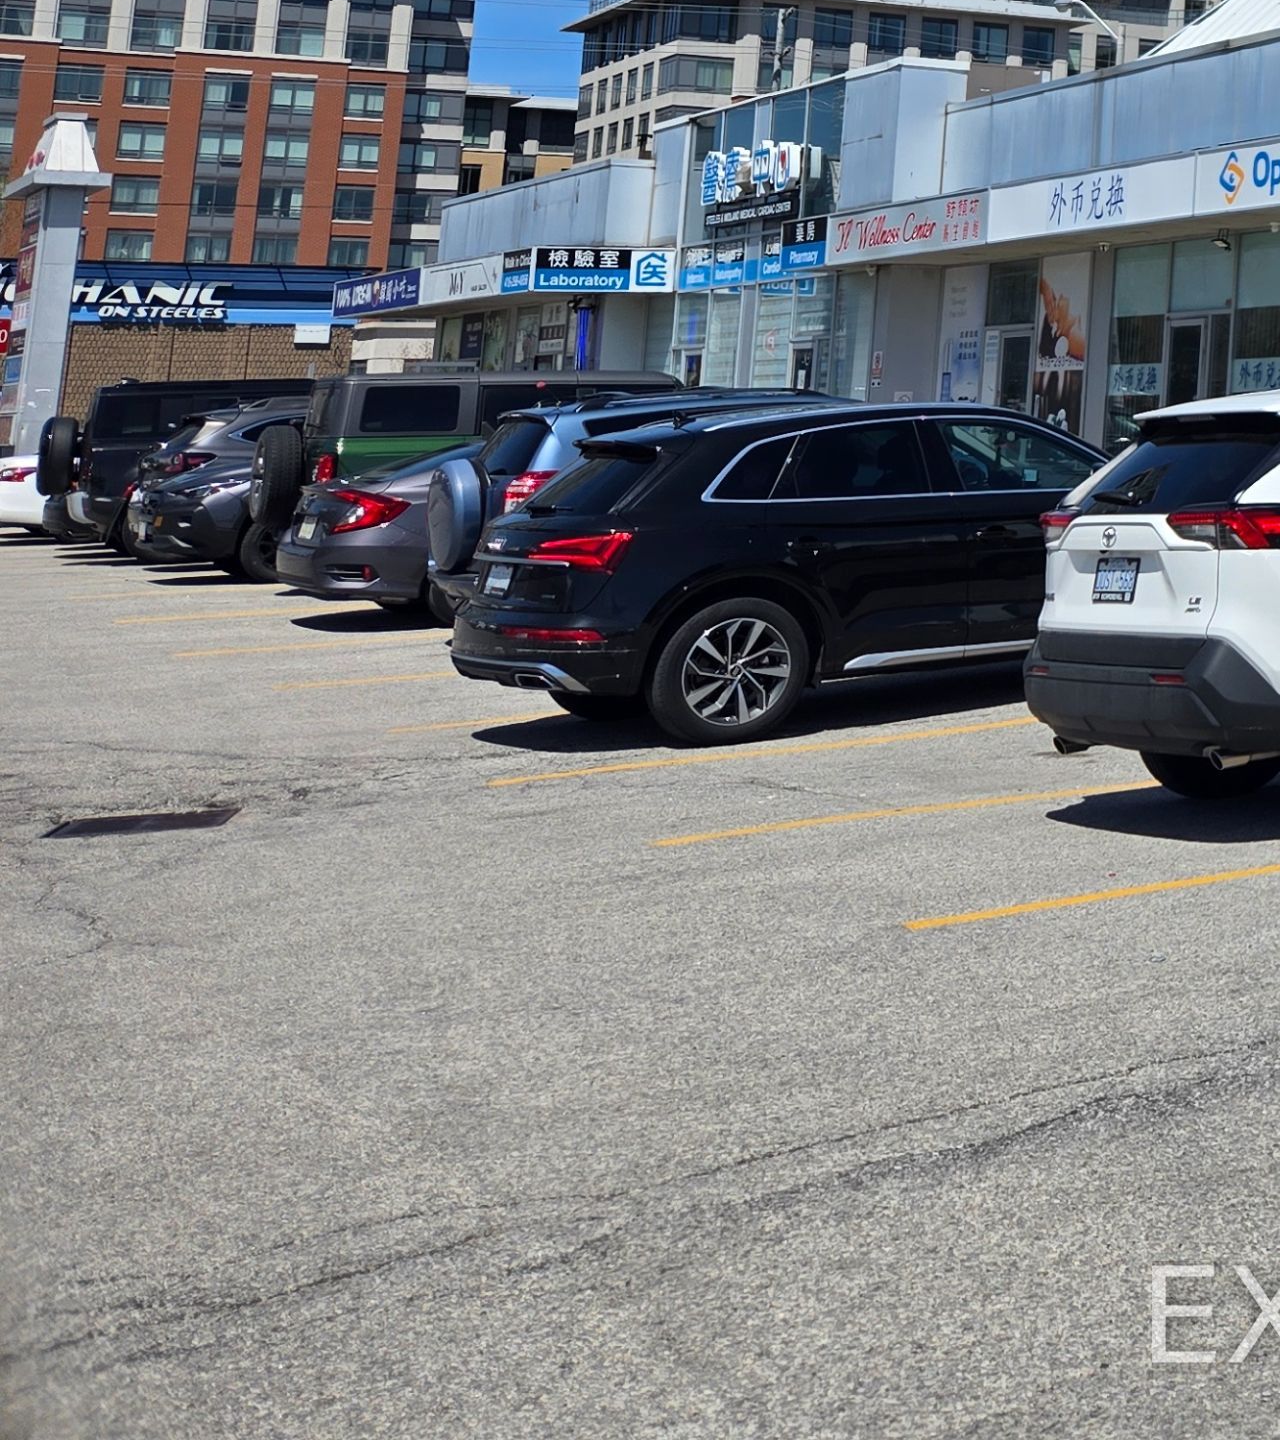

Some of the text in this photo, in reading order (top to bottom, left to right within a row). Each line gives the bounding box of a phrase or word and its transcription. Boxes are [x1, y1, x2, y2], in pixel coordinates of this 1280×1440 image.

[1049, 173, 1126, 226] 外币兑换
[856, 214, 901, 250] Wellness
[903, 212, 936, 242] Center
[789, 250, 818, 265] Pharmacy
[539, 273, 624, 289] Laboratory
[98, 306, 228, 319] ON STEELES
